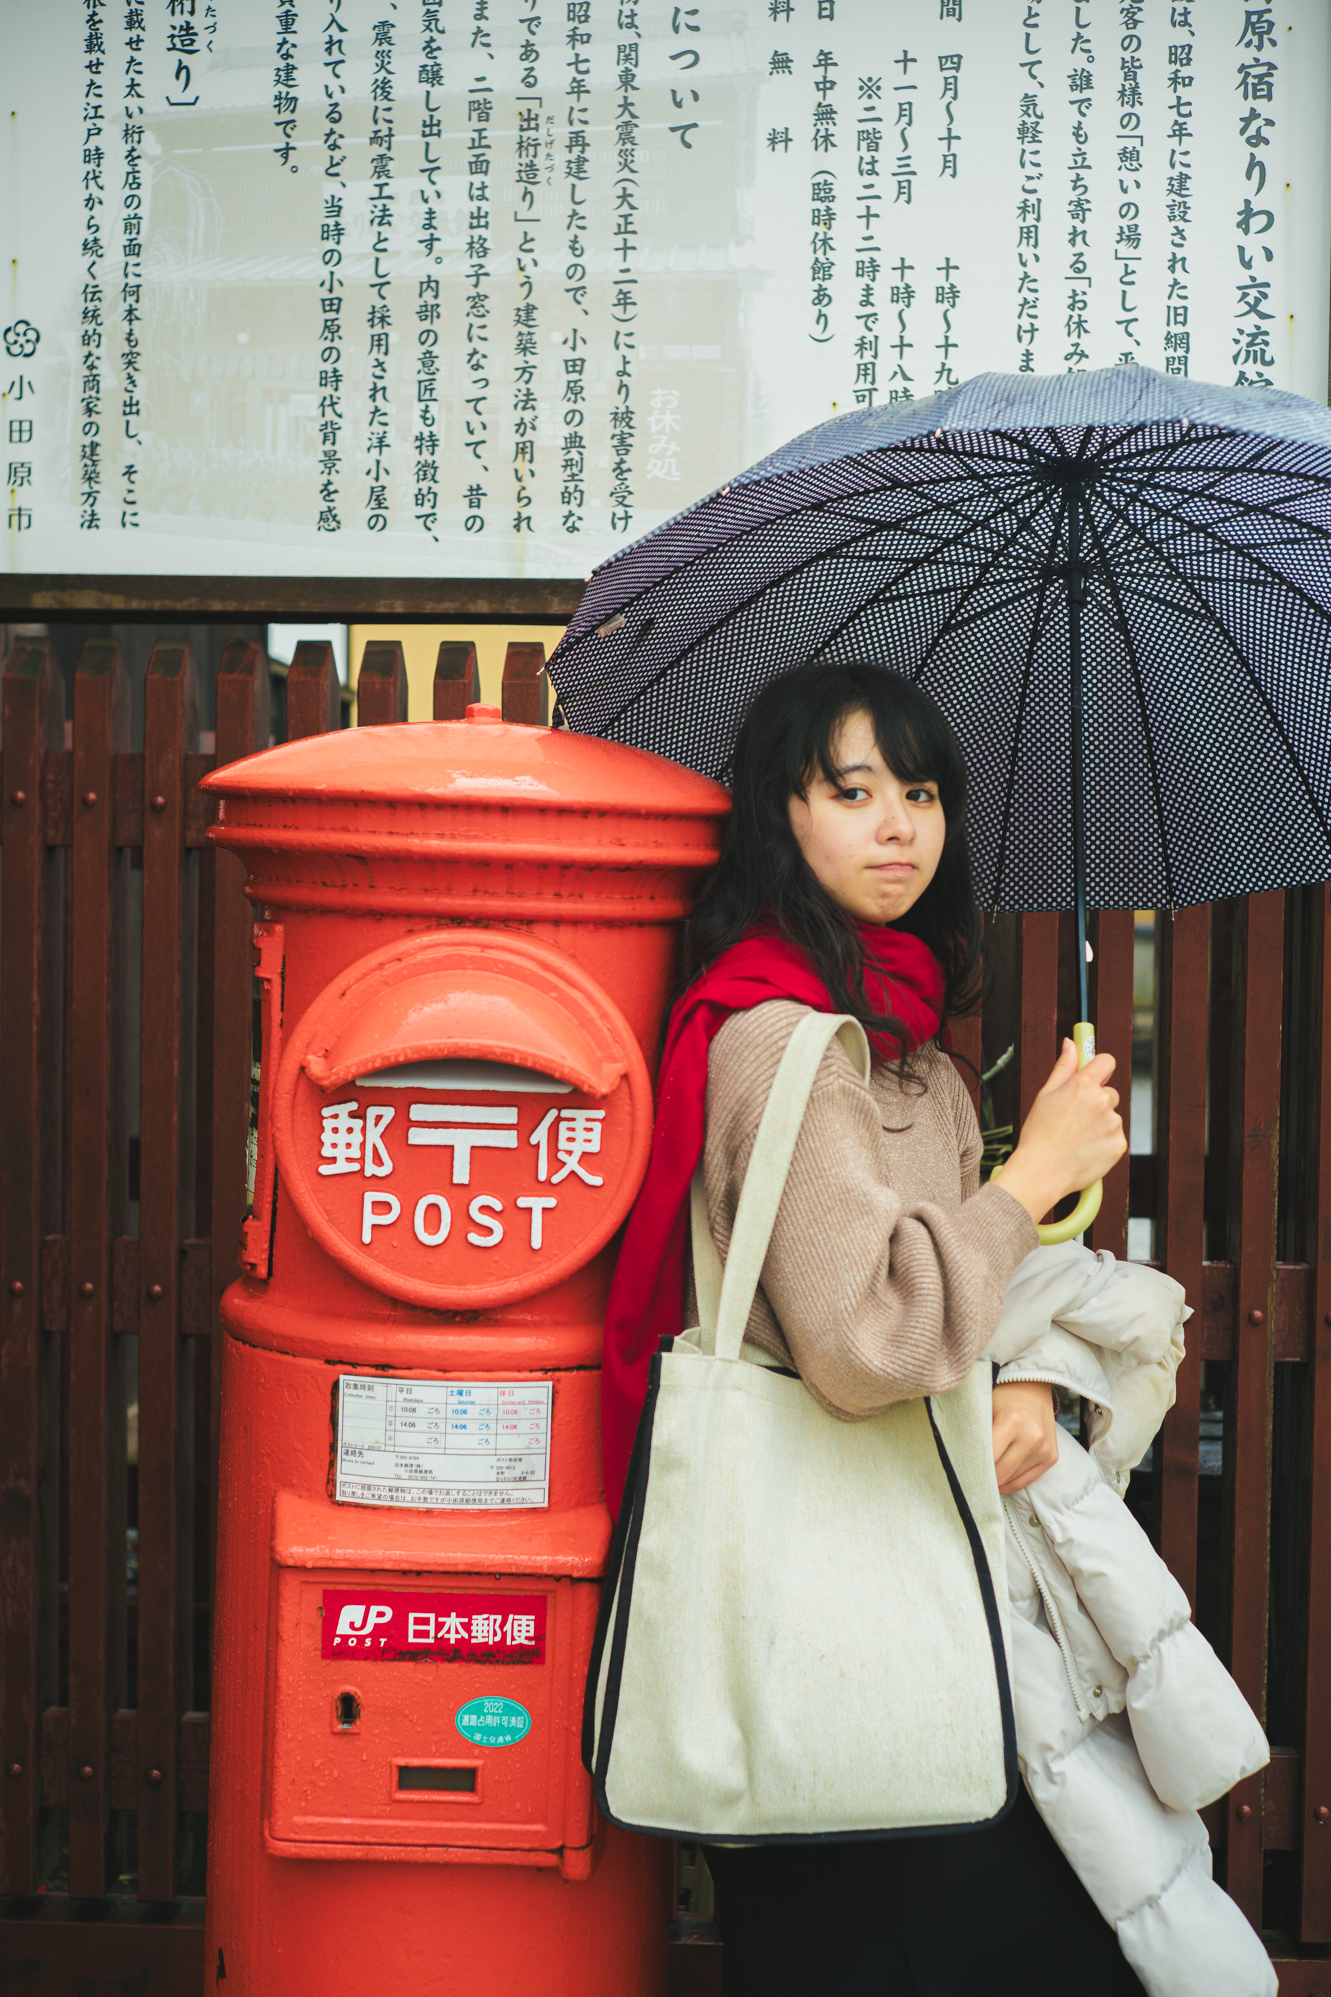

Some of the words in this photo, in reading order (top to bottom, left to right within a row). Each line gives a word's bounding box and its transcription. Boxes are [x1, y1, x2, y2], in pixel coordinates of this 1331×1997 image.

[203, 4, 218, 54] たづく
[272, 0, 300, 174] 重な建物です。
[668, 6, 701, 150] について
[1015, 0, 1045, 373] として、気軽にご利用いただけま
[1063, 0, 1095, 374] した。誰でも立ち寄れる「お休み
[1114, 0, 1145, 367] 客の皆様の「憩いの場」として、平
[1163, 0, 1196, 377] は、昭和七年に建設された旧網問
[1228, 0, 1278, 387] 原宿なりわい交流
[120, 0, 147, 529] 載せた太い桁を店の前面に何本も突き出し、そこに
[413, 0, 447, 543] 気を醸し出しています。内部の意匠も特徴的で、
[608, 0, 642, 533] は、関東大震災(大正十二年)により被害を受け
[934, 256, 967, 397] 十時〜十九
[7, 374, 35, 532] 小田原市
[645, 386, 682, 482] お休み処
[361, 1191, 558, 1250] POST
[398, 1386, 413, 1395] 平日
[448, 1389, 472, 1397] 土曜日
[499, 1389, 515, 1397] 休日
[427, 1407, 441, 1415] ごろ
[478, 1408, 492, 1416] ごろ
[528, 1437, 541, 1445] ごろ
[333, 1637, 388, 1648] POST
[407, 1611, 536, 1646] 日本郵便
[483, 1701, 504, 1713] 2022
